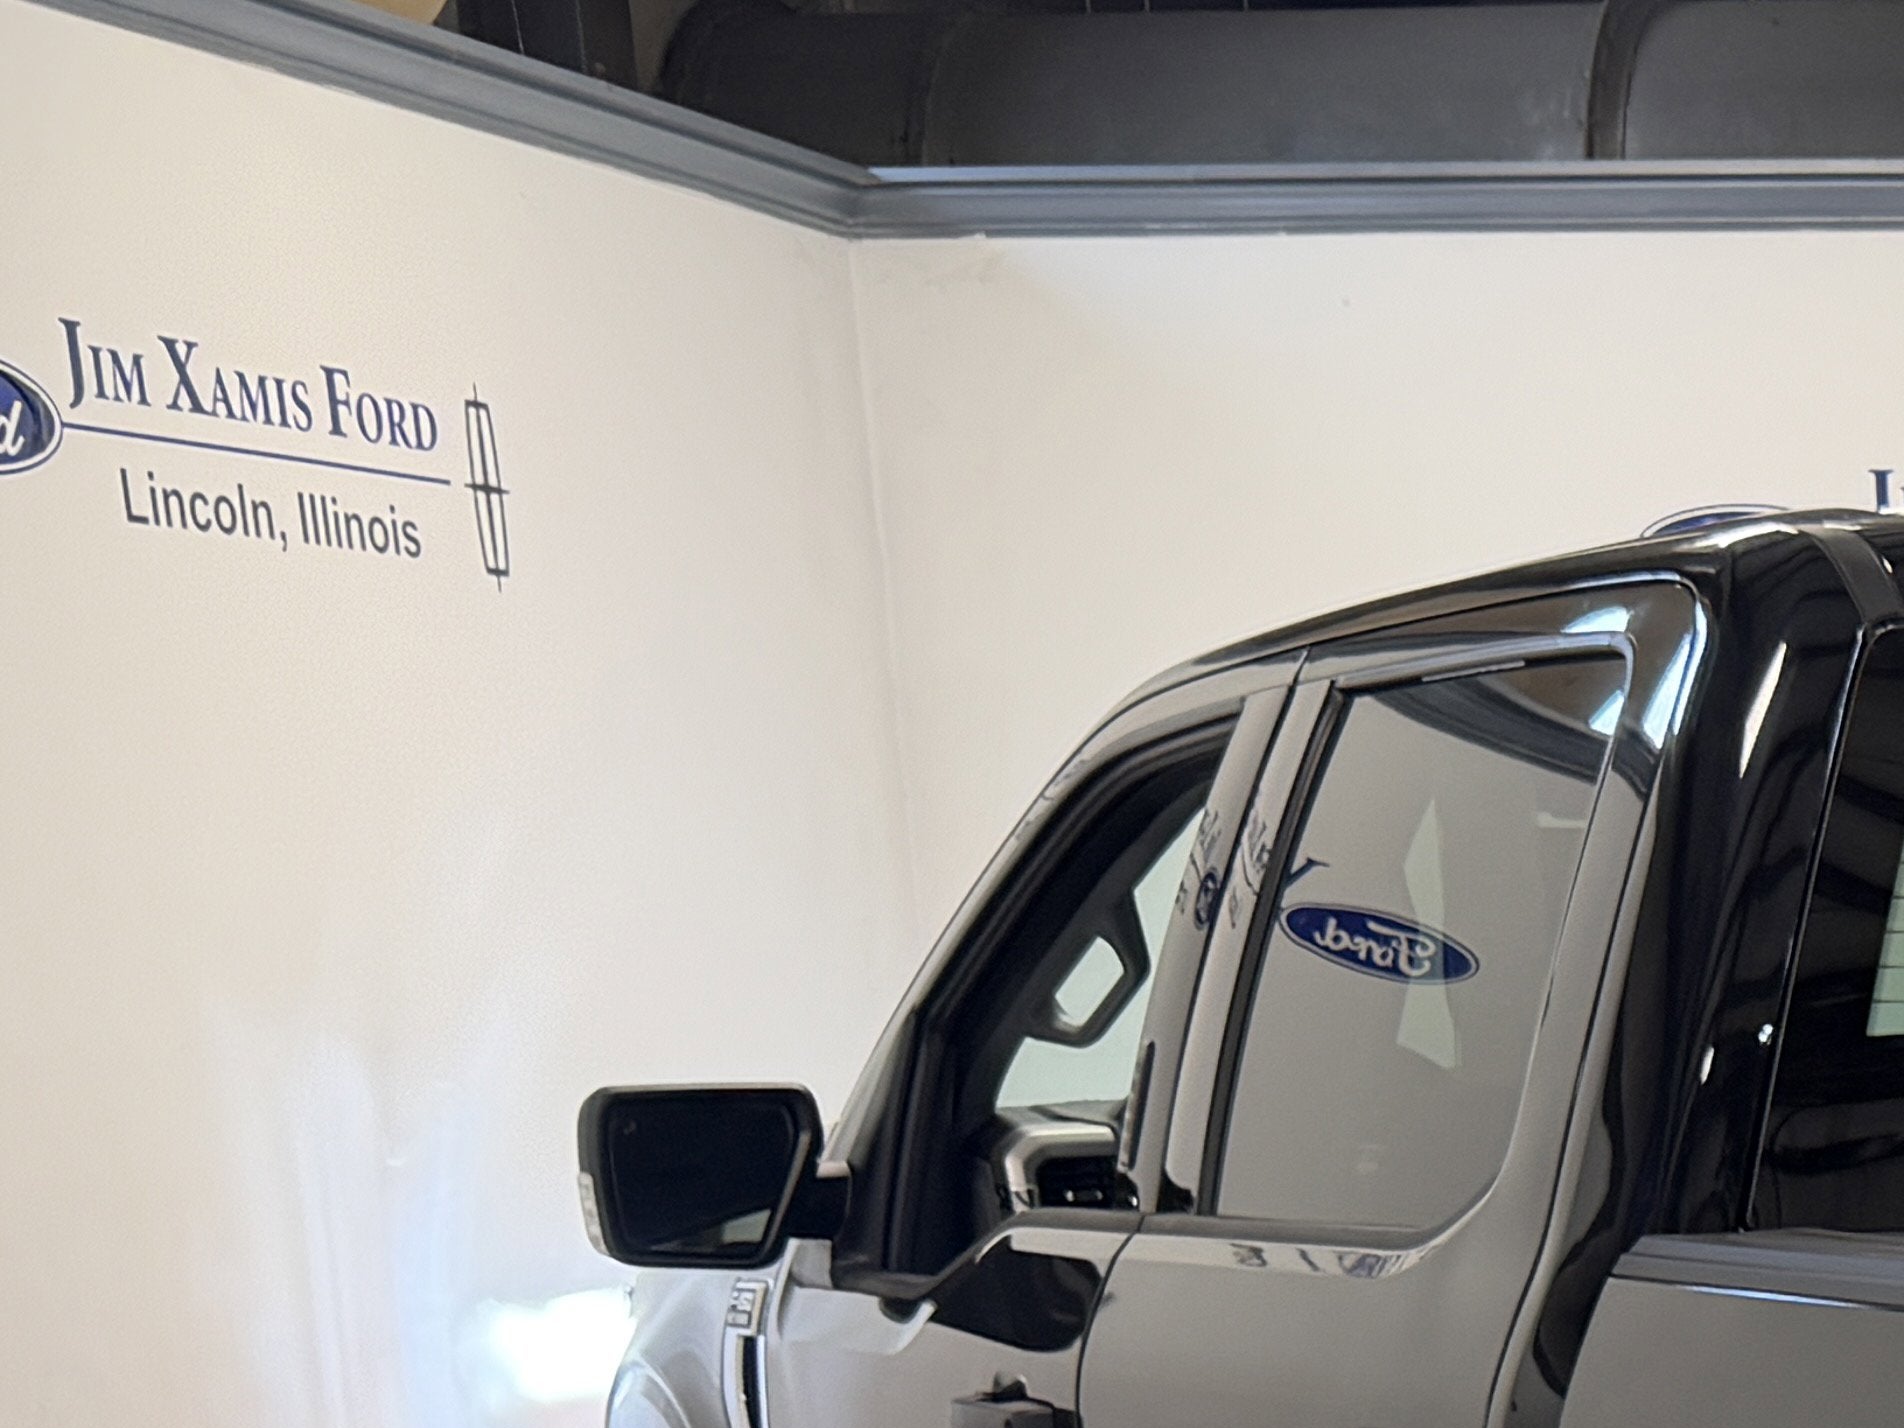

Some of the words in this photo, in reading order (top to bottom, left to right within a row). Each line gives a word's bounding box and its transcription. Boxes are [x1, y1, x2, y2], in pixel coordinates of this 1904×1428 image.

[57, 316, 152, 409] JIM
[156, 335, 313, 432] XAMIS
[319, 363, 438, 452] FORD
[119, 467, 288, 552] Lincoln,
[297, 491, 422, 559] Illinois
